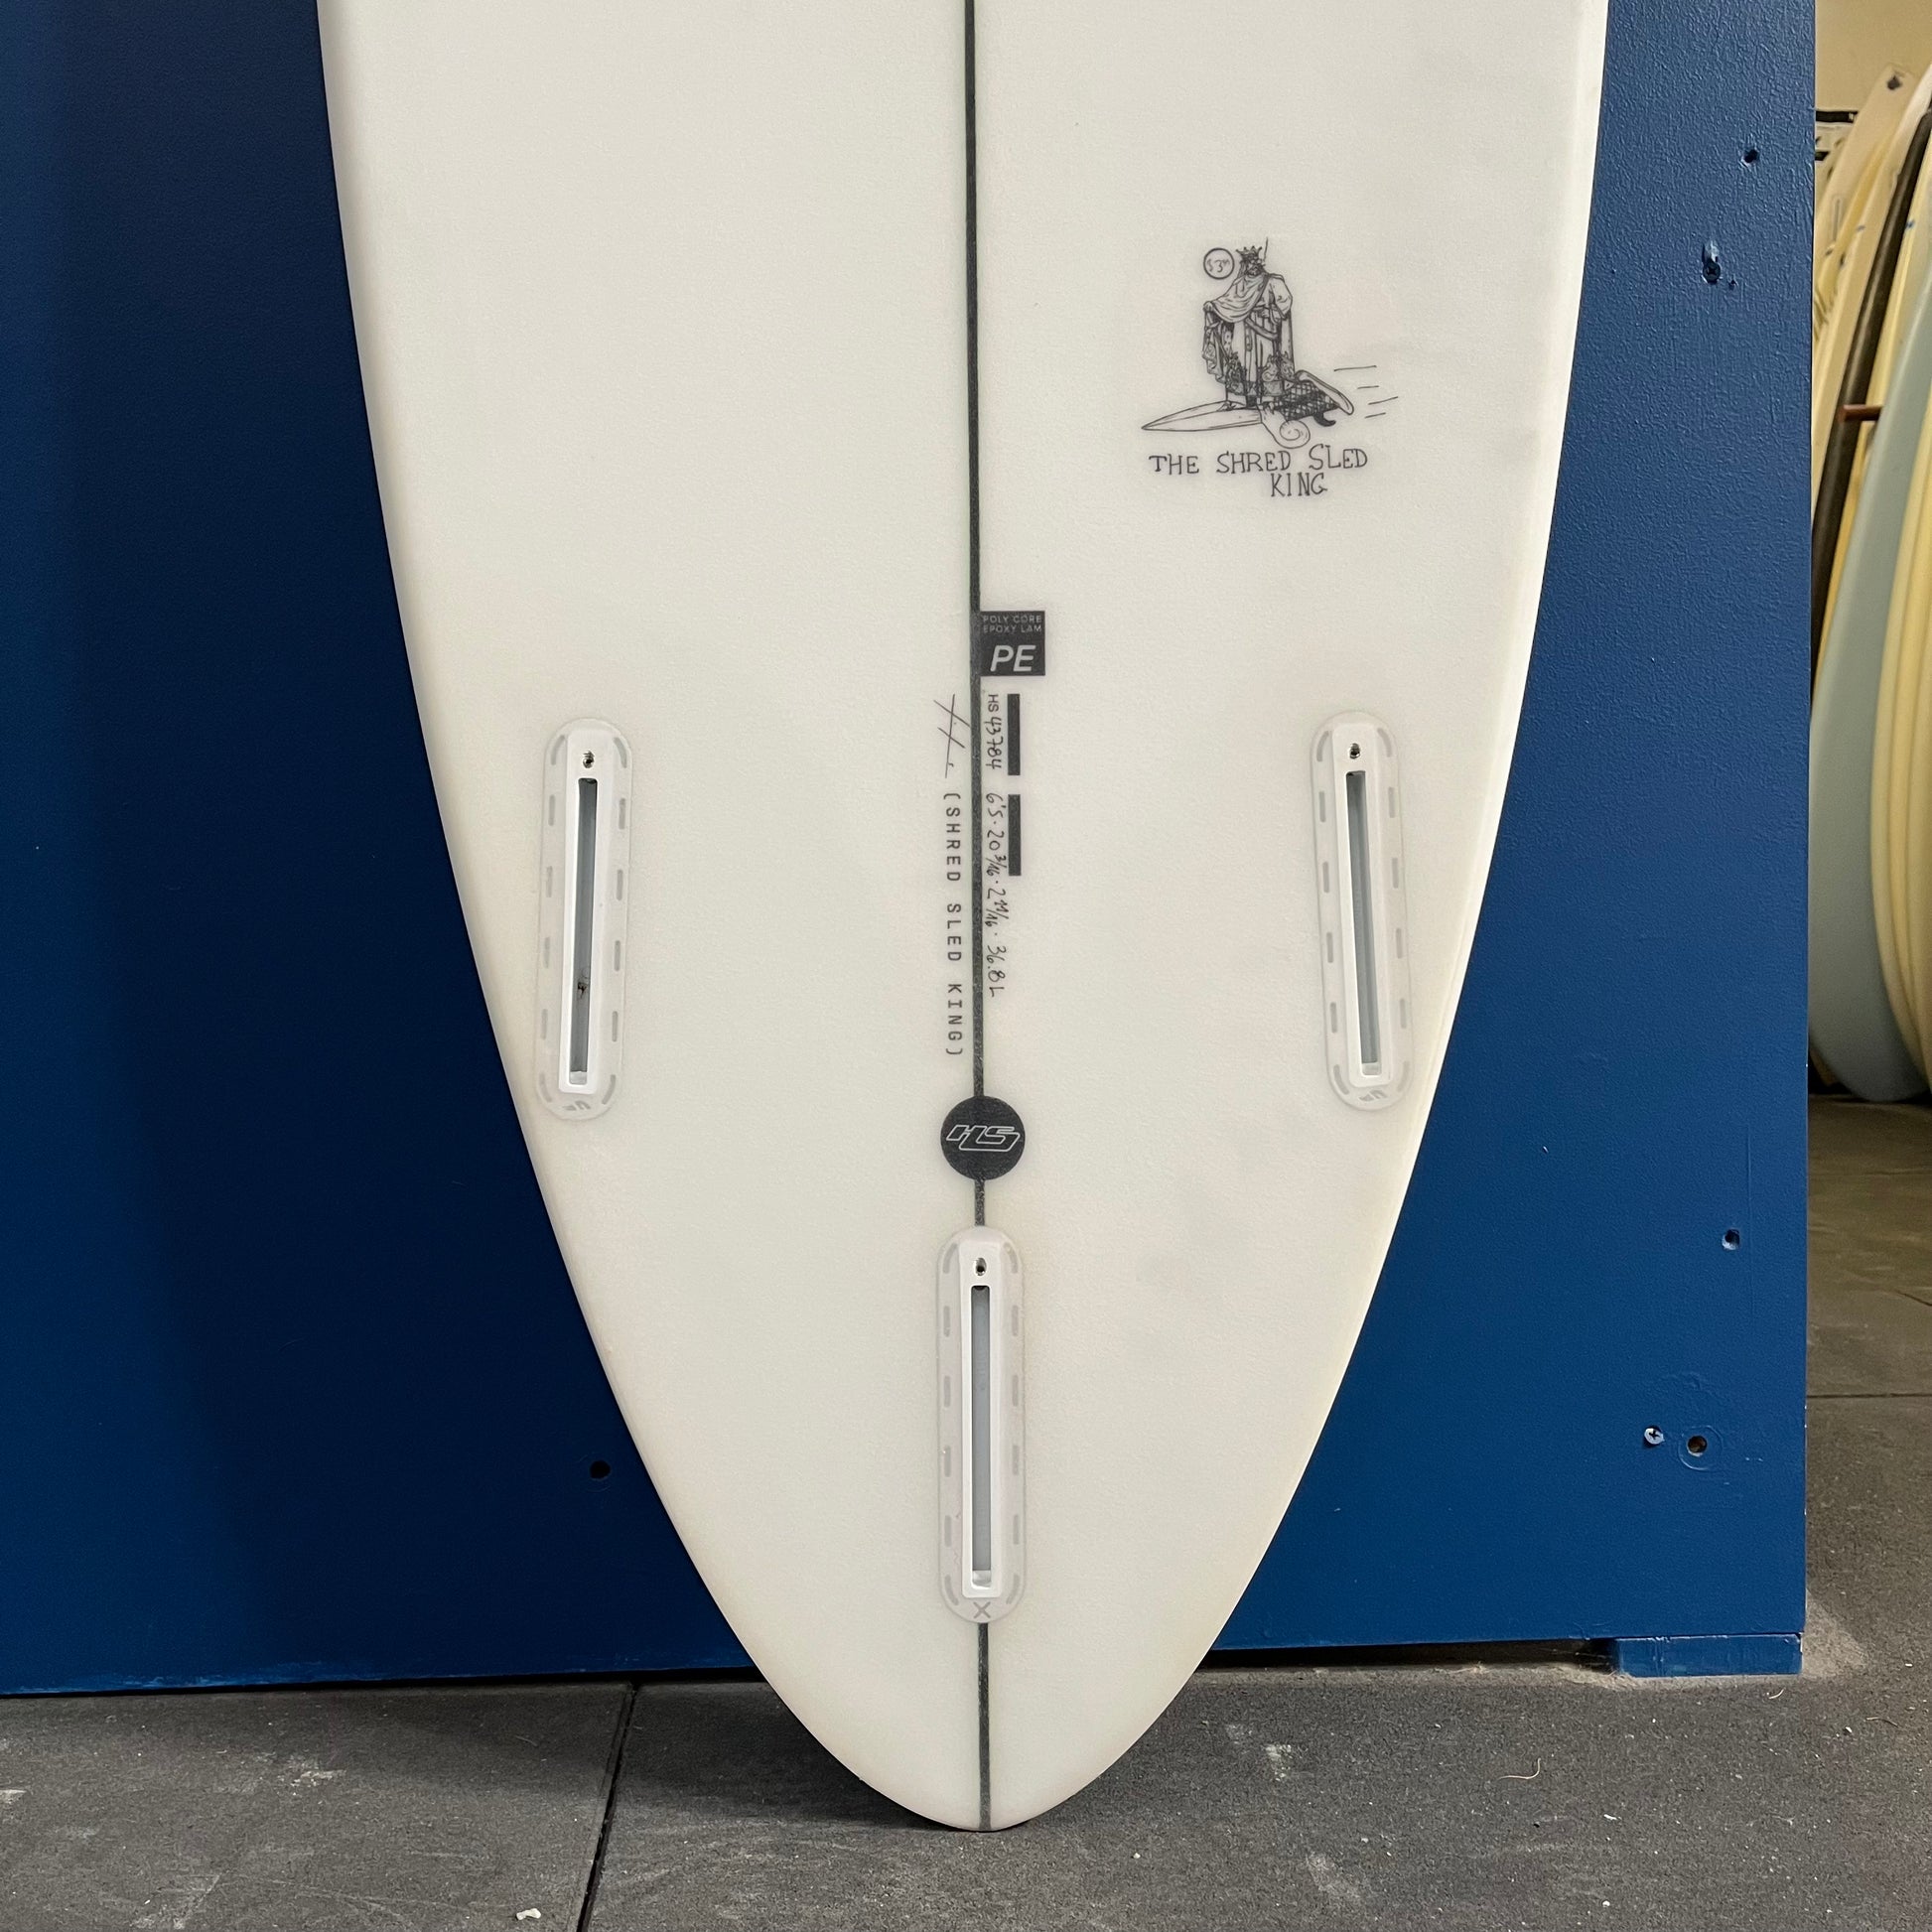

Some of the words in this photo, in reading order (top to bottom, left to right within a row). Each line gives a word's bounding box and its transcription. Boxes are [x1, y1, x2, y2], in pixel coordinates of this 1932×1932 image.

[1149, 453, 1199, 476] THE
[1216, 451, 1292, 474] SHRED
[1309, 443, 1368, 472] SLED
[1271, 472, 1328, 497] KING
[982, 615, 1009, 624] POLY
[1013, 615, 1042, 623] CORE
[983, 624, 1018, 633] EPOXY
[1021, 624, 1042, 633] LAM
[990, 644, 1036, 672] PE
[987, 694, 1000, 713] HS
[946, 903, 962, 961] SLED
[945, 1124, 1021, 1153] HS
